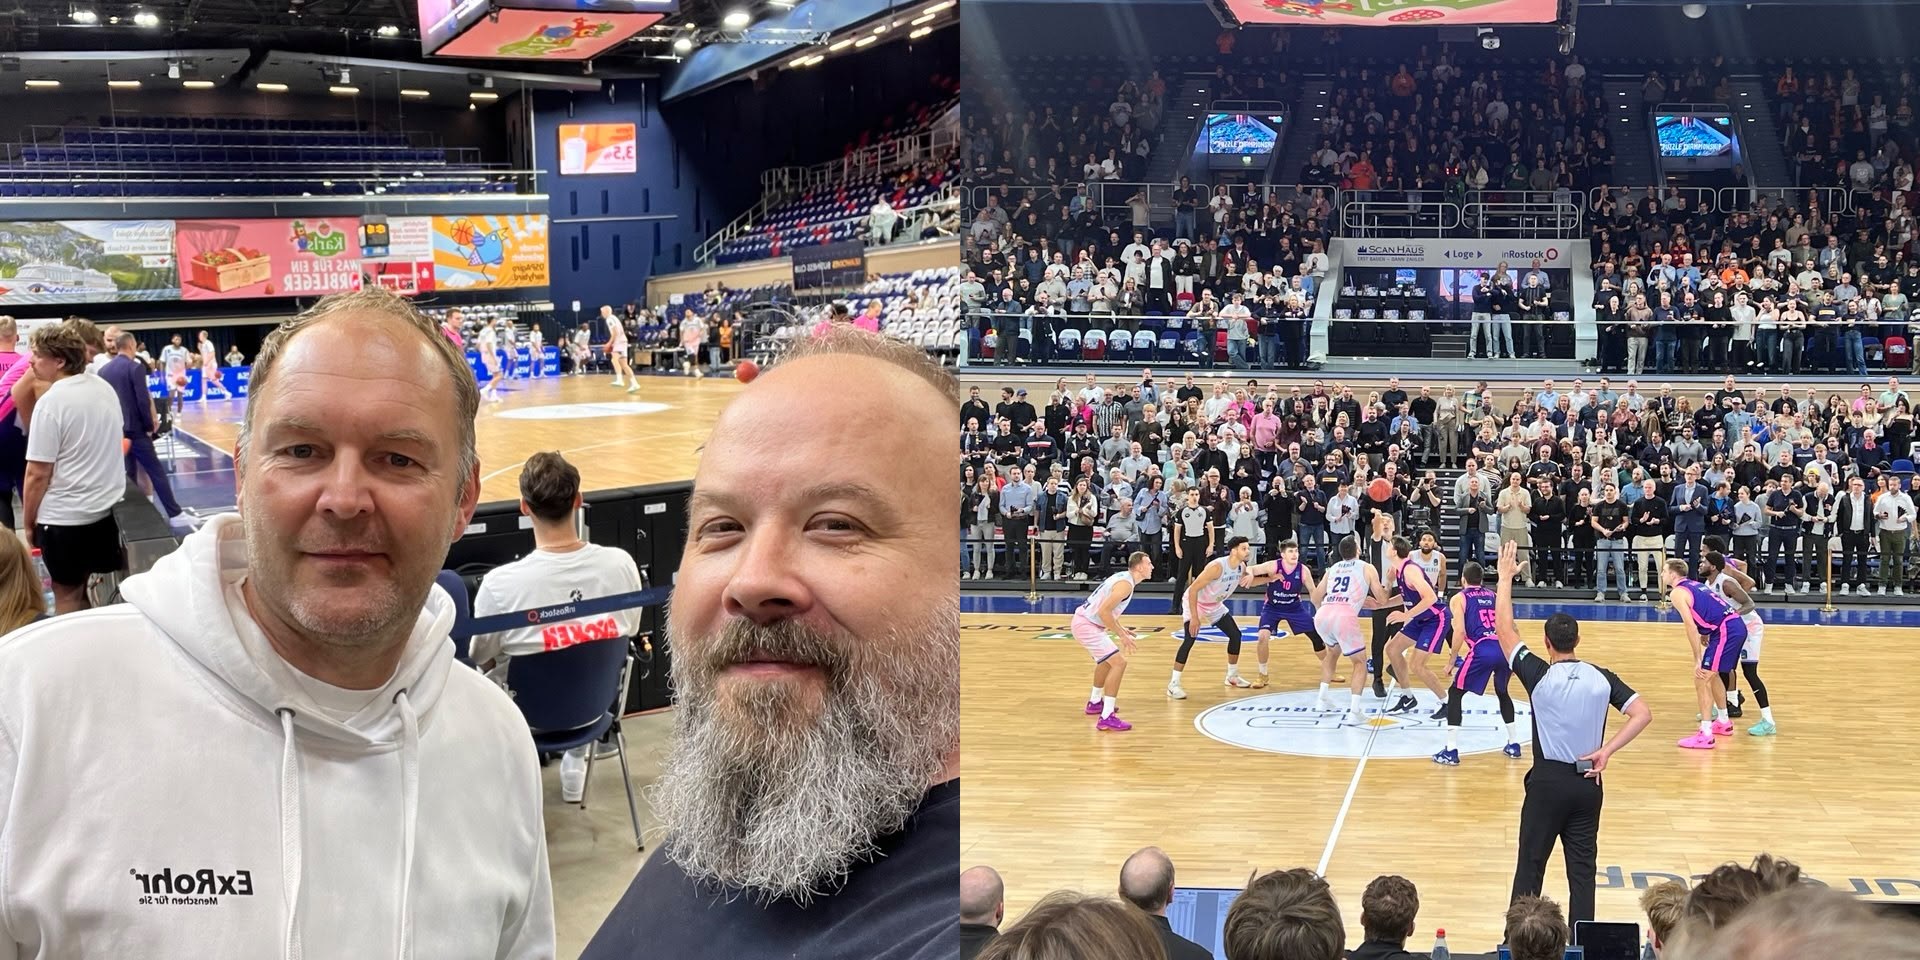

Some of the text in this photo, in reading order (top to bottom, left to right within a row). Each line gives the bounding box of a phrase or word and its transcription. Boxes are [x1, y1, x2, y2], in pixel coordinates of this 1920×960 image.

[1369, 245, 1425, 253] SCAN HAUS
[1453, 250, 1474, 259] Loge
[1501, 250, 1544, 259] inRostock
[1281, 580, 1292, 591] 10
[1332, 575, 1350, 593] 29
[1479, 608, 1496, 628] 55
